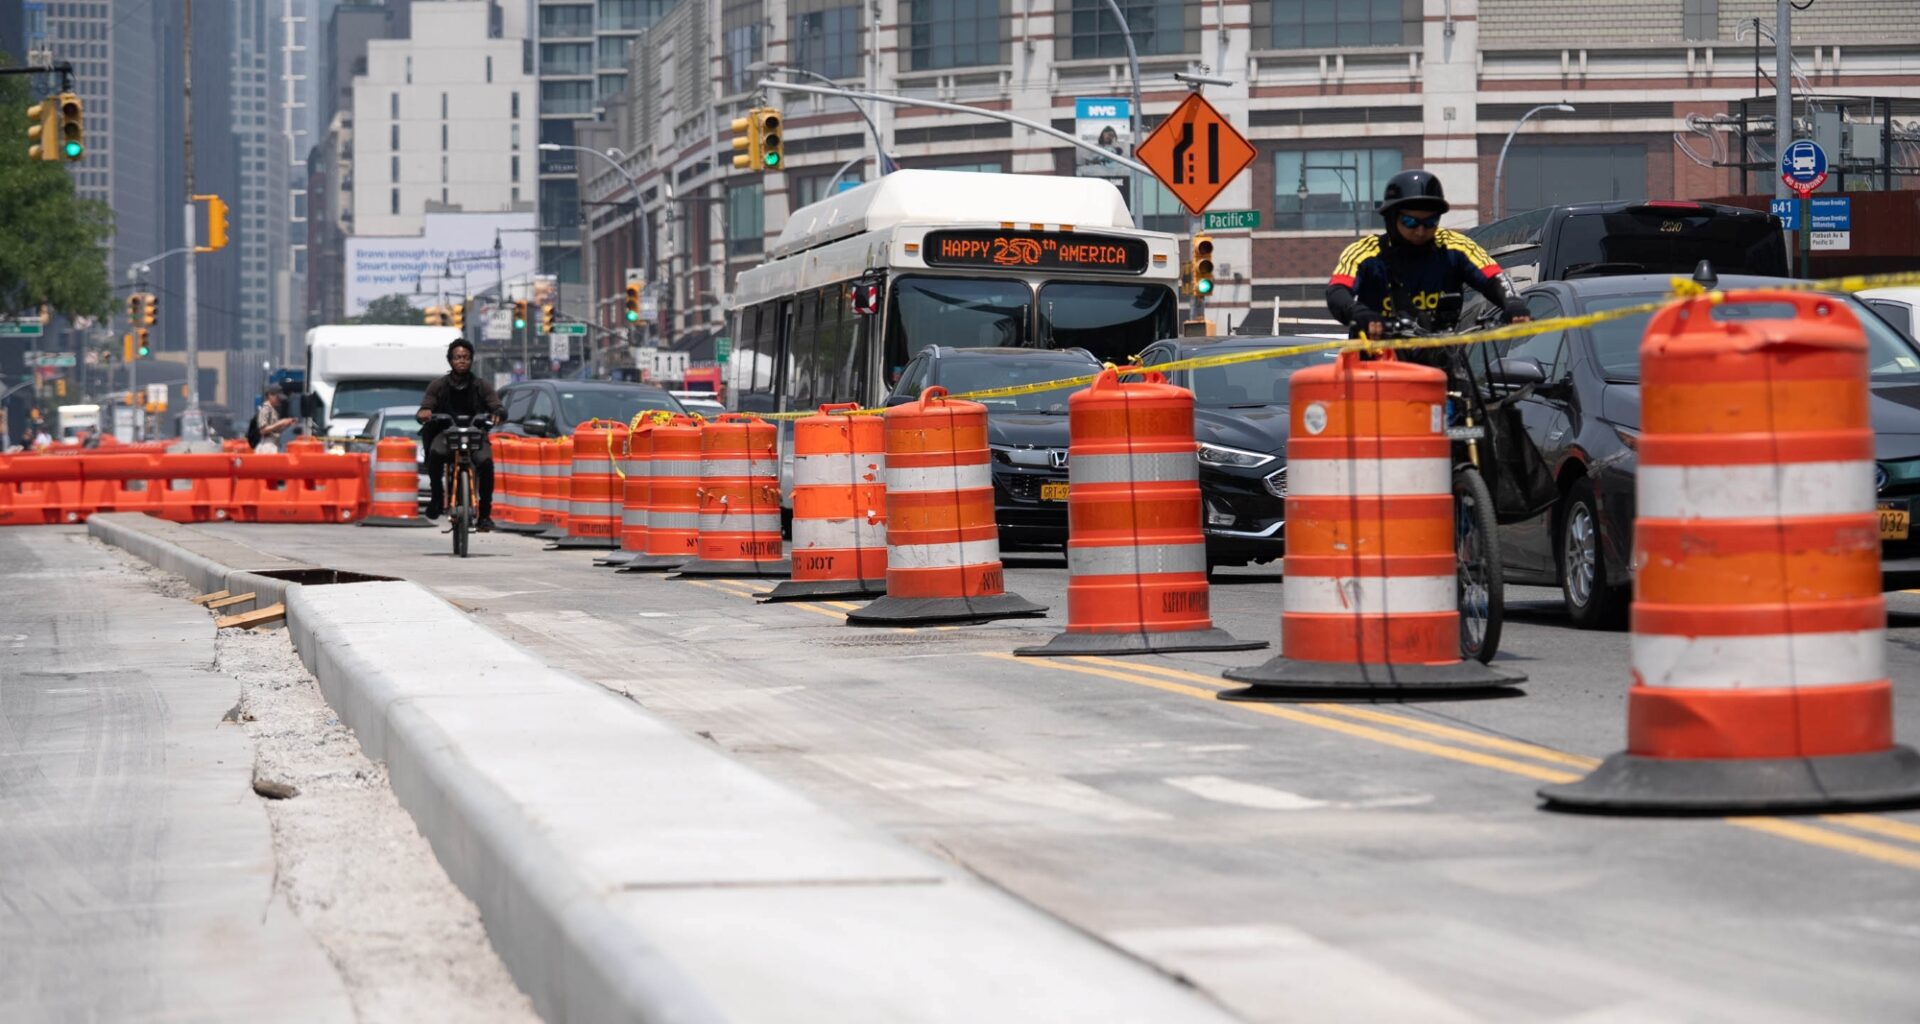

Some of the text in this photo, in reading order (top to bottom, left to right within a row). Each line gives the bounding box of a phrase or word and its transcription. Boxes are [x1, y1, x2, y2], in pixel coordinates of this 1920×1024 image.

[1088, 105, 1116, 116] NYC
[1785, 174, 1824, 190] NO STANDING
[1772, 201, 1791, 213] B41
[1210, 212, 1253, 228] Pacific St
[388, 249, 429, 261] enough
[941, 239, 990, 258] HAPPY
[1059, 244, 1126, 264] AMERICA
[391, 262, 430, 273] enough
[432, 262, 447, 271] no
[1880, 512, 1904, 532] 032
[740, 541, 767, 556] SAFETY
[807, 556, 834, 570] DOT
[1162, 591, 1187, 613] SAFETY
